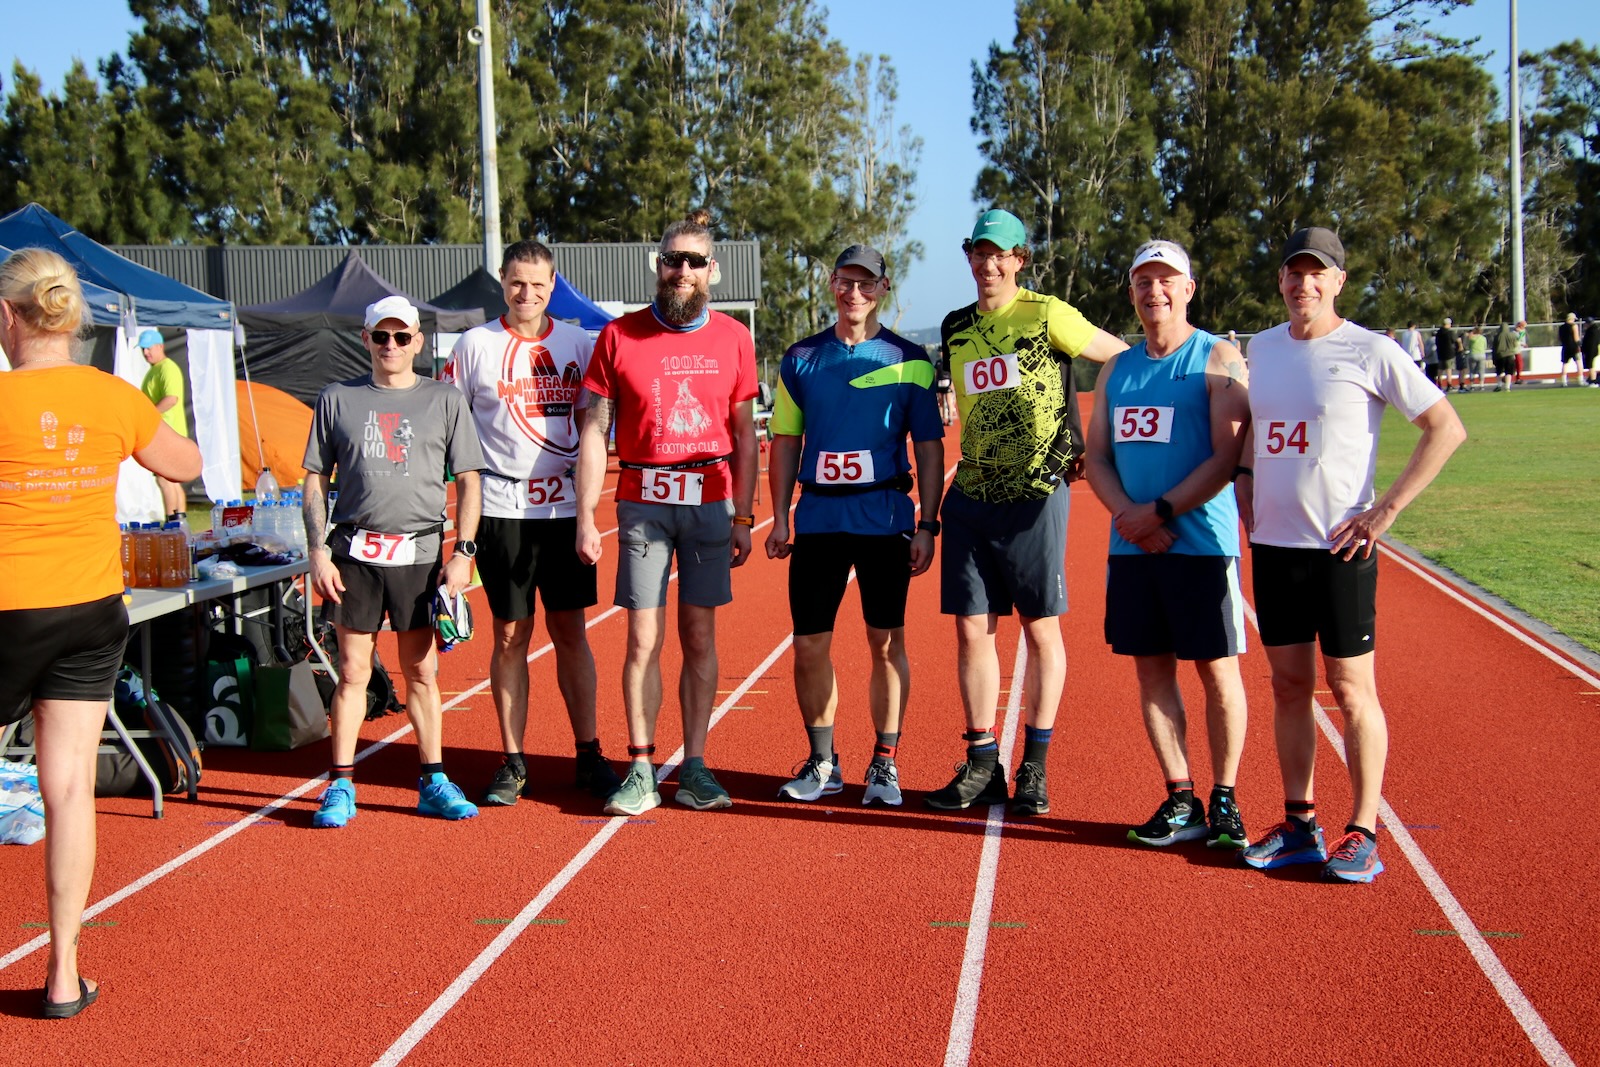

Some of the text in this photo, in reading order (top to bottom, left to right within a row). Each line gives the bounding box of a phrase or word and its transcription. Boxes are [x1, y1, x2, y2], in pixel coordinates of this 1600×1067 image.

[523, 376, 562, 389] MEGA
[972, 357, 1008, 390] 60
[364, 410, 401, 428] JUST
[1120, 408, 1160, 438] 53
[656, 440, 719, 455] FOOTING CLUB
[1266, 421, 1309, 454] 54
[25, 465, 99, 478] SPECIAL CARE
[823, 453, 862, 481] 55
[25, 480, 78, 491] DISTANCE
[528, 476, 566, 505] 52
[652, 472, 687, 501] 51
[361, 532, 404, 561] 57
